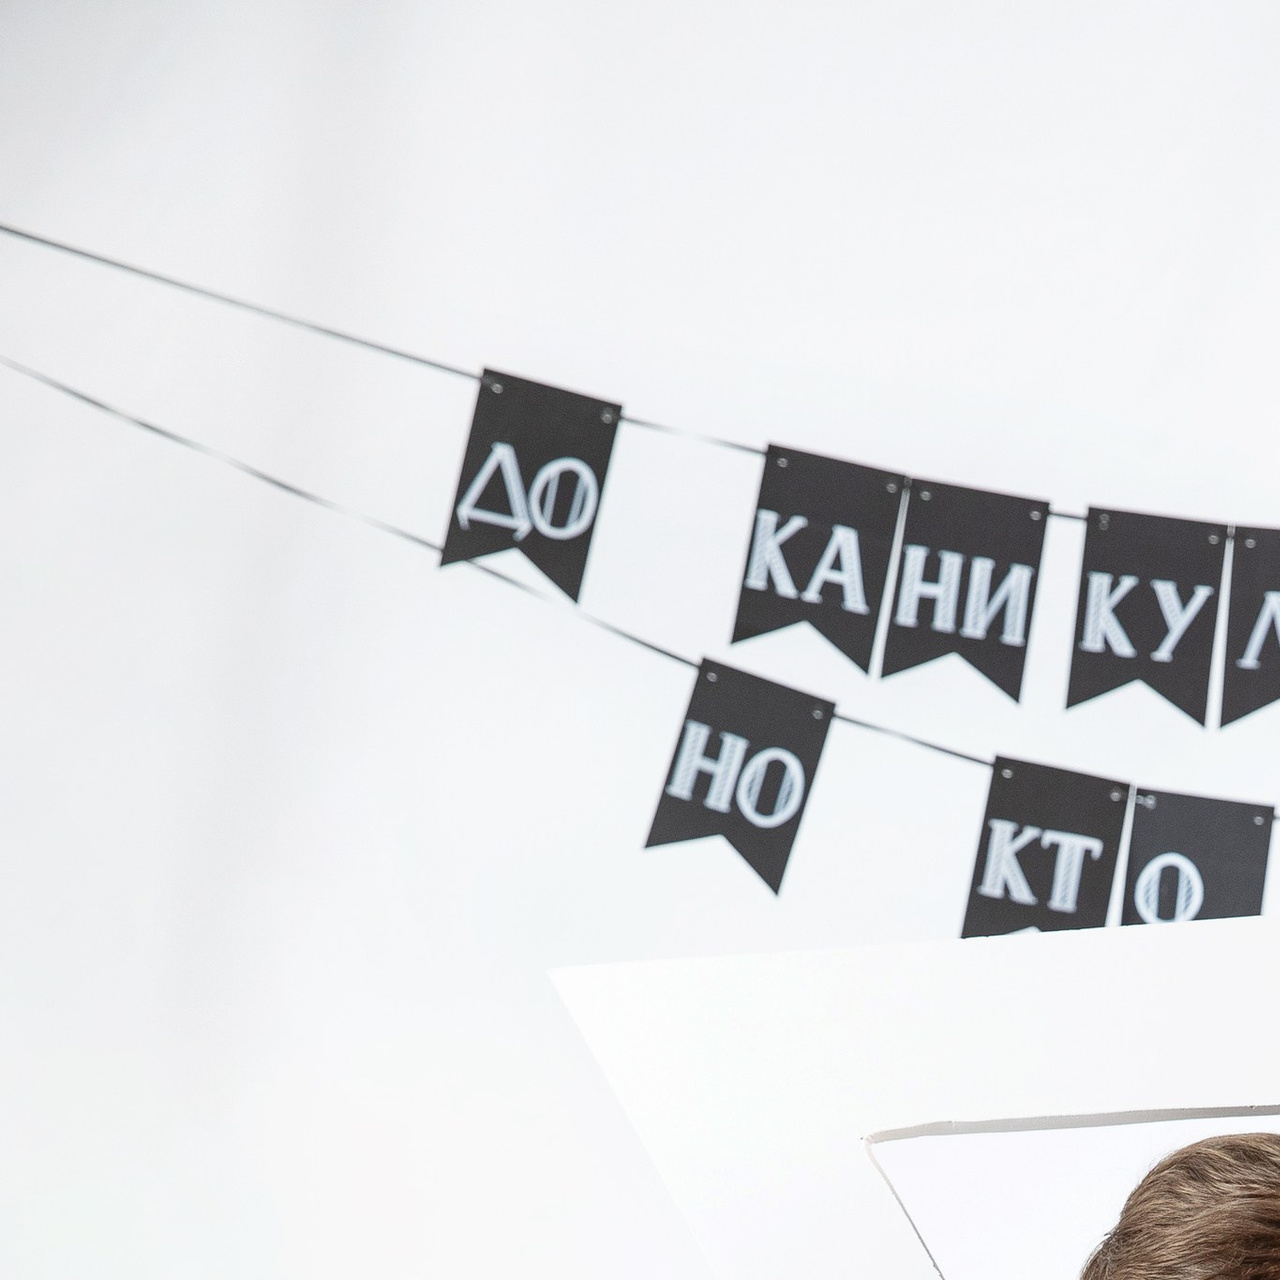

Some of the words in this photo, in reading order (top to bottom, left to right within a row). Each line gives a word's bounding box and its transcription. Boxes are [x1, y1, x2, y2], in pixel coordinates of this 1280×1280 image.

[456, 441, 600, 541] ДО
[664, 719, 806, 830] НО
[976, 818, 1204, 923] КТО
